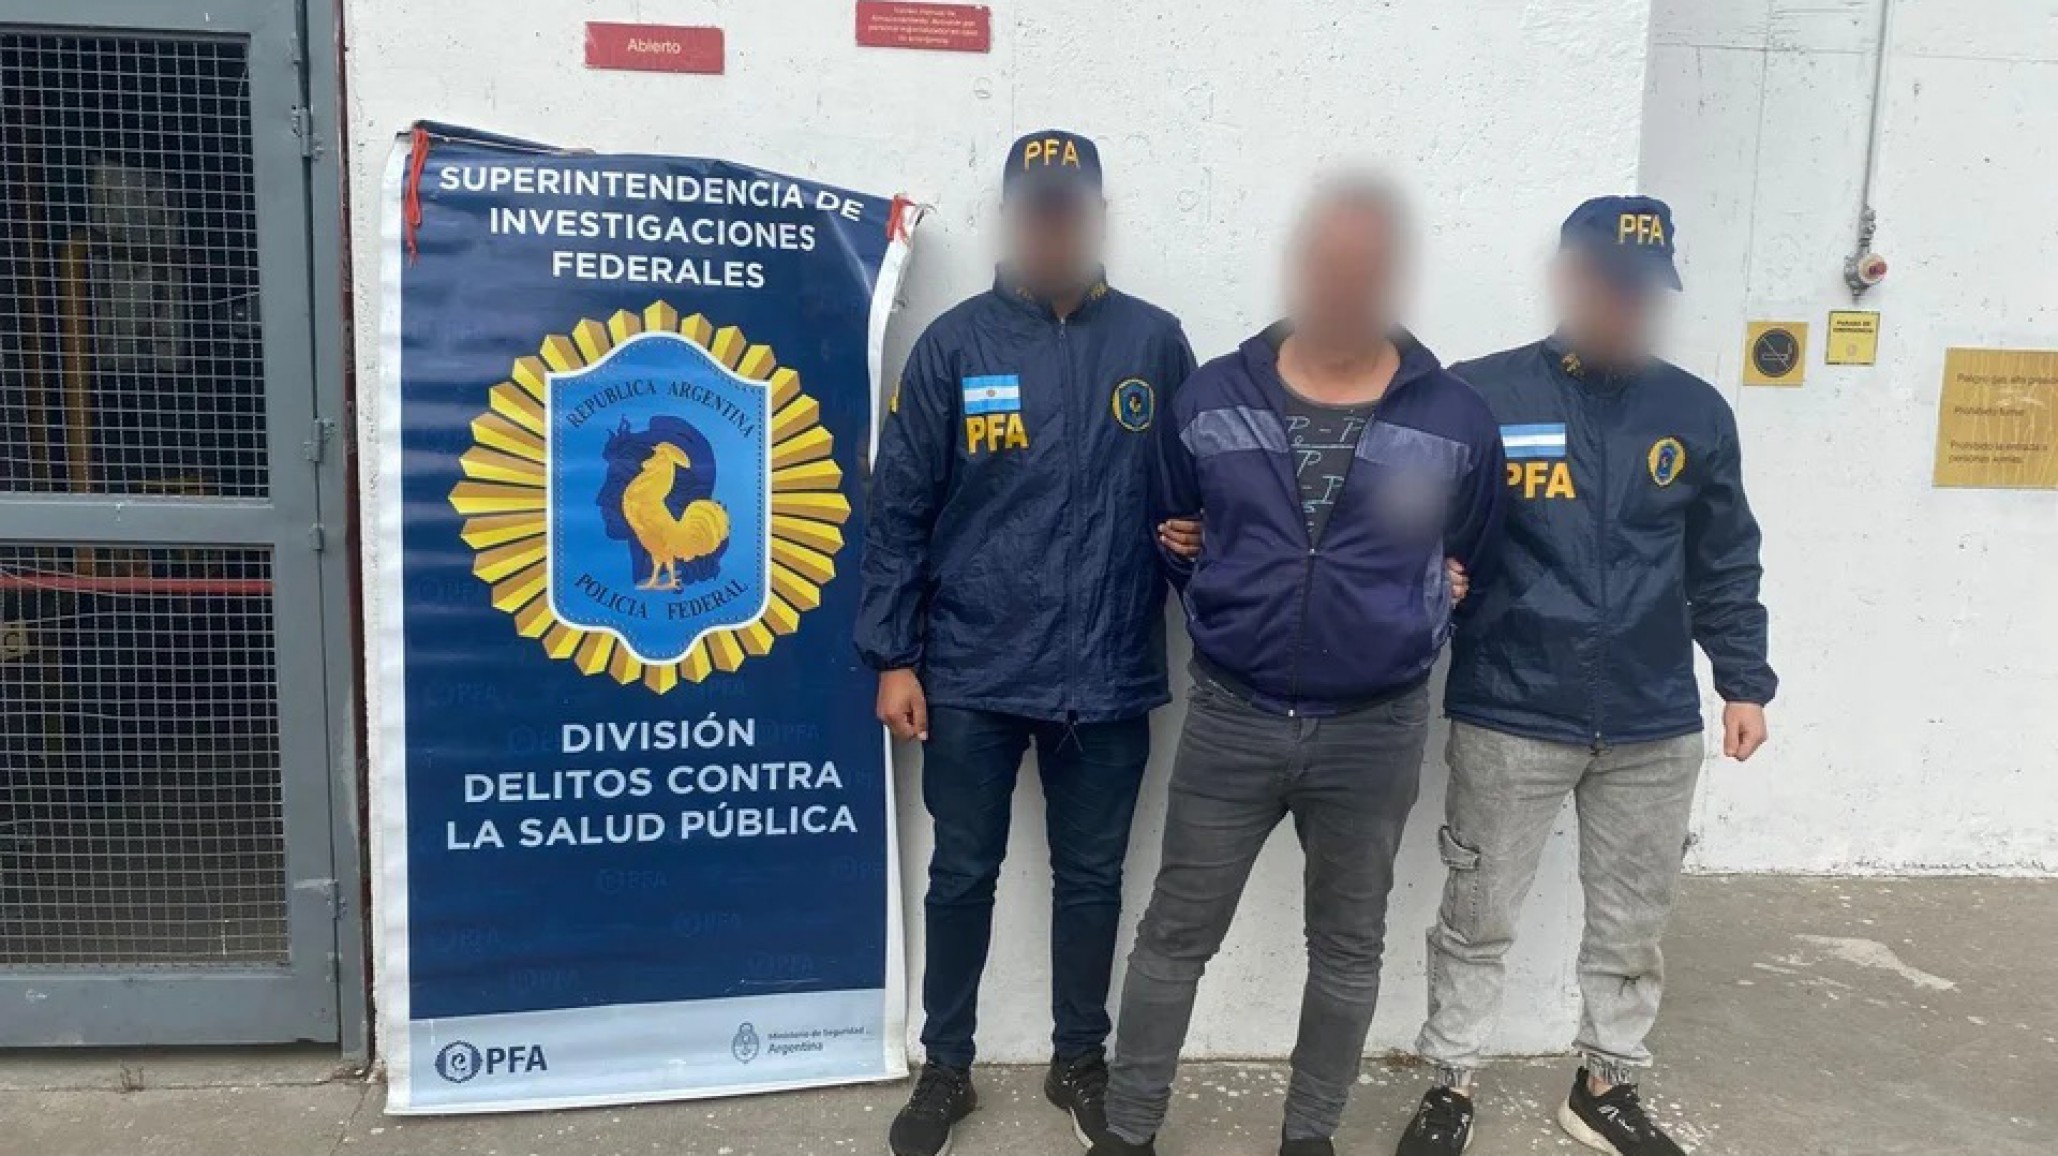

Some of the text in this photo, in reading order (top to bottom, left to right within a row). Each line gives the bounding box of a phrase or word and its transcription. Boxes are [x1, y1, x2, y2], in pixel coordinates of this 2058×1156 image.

[627, 38, 682, 54] Abierto
[1024, 139, 1081, 169] PFA
[440, 166, 865, 221] SUPERINTENDENCIA DE
[490, 207, 816, 250] INVESTIGACIONES
[1618, 213, 1665, 245] PFA
[552, 251, 765, 288] FEDERALES
[667, 381, 755, 439] ARGENTINA
[965, 413, 1030, 454] PFA
[668, 579, 749, 620] FEDERAL
[561, 712, 756, 754] DIVISIÓN
[464, 761, 843, 803] DELITOS CONTRA
[447, 802, 858, 850] LA SALUD PÚBLICA
[767, 1042, 824, 1056] Argentina
[823, 1026, 865, 1038] Seguridad
[486, 1044, 549, 1075] PFA
